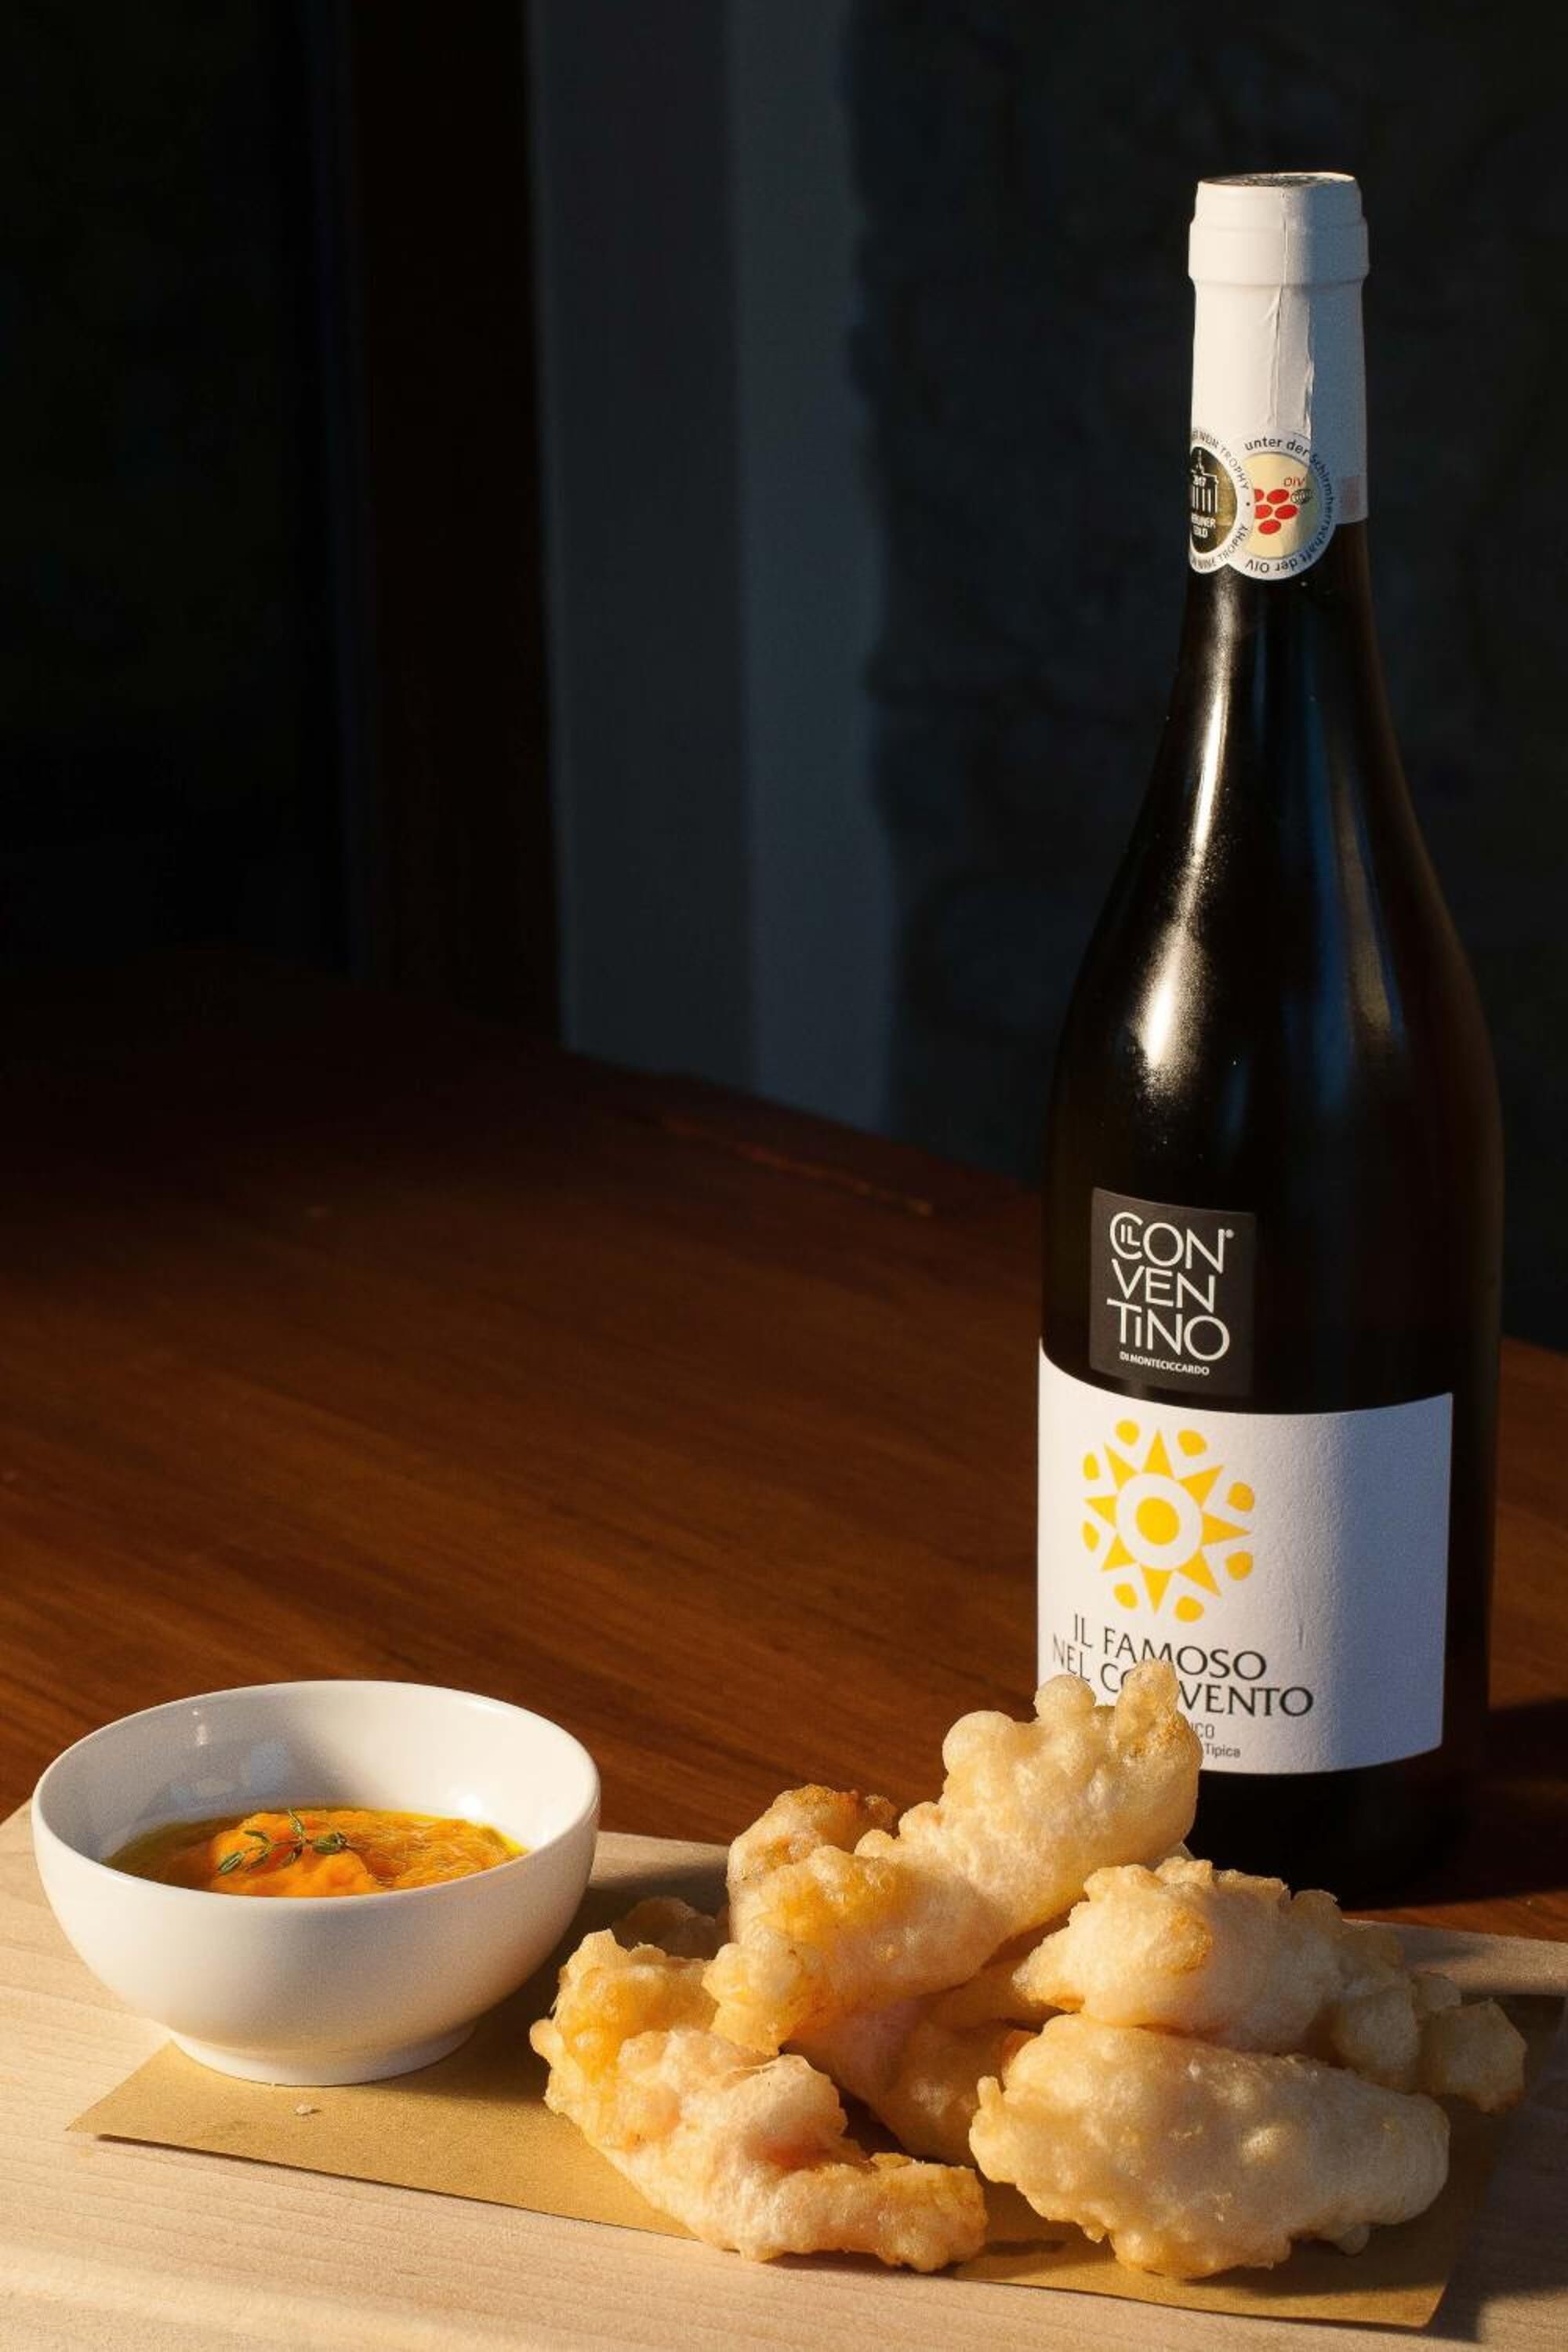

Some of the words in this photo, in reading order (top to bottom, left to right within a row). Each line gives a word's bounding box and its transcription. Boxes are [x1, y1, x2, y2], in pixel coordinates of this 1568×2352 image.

[1245, 436, 1283, 451] unter
[1287, 440, 1308, 456] der
[1220, 447, 1249, 489] TROPHY
[1218, 522, 1248, 562] TROPHY
[1245, 559, 1269, 573] OIV
[1275, 558, 1298, 572] der
[1120, 1224, 1141, 1246] IL
[1112, 1258, 1215, 1313] VEN
[1120, 1351, 1129, 1362] DI
[1131, 1354, 1210, 1376] MONTECICCARDO
[1075, 1613, 1093, 1648] IL
[1104, 1626, 1266, 1680] FAMOSO
[1053, 1632, 1091, 1682] NEL
[1101, 1663, 1313, 1717] CVENTO
[1205, 1743, 1240, 1759] Tipica
